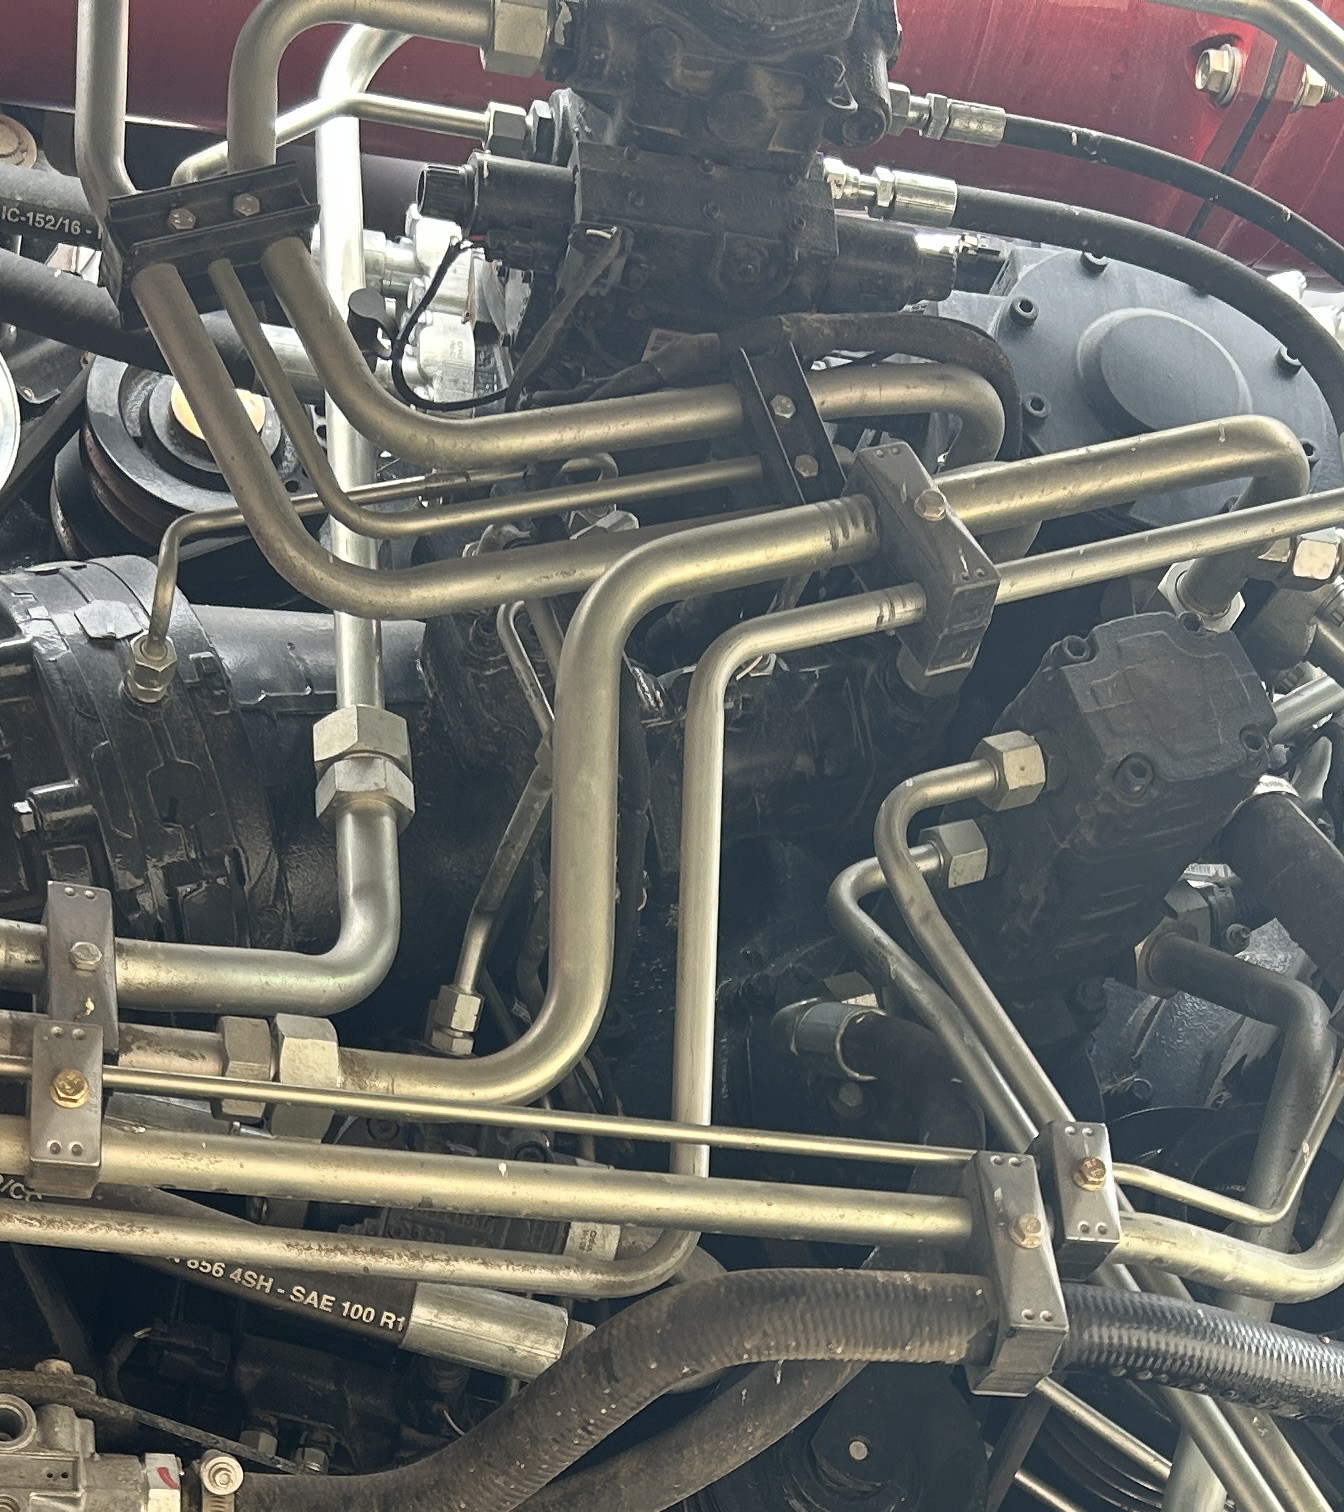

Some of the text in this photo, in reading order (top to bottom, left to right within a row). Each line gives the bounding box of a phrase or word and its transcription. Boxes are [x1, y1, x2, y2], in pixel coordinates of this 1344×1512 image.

[1, 205, 82, 236] IC-152/16
[229, 1267, 274, 1295] 4SH
[289, 1285, 336, 1313] SAE
[341, 1301, 376, 1324] 100
